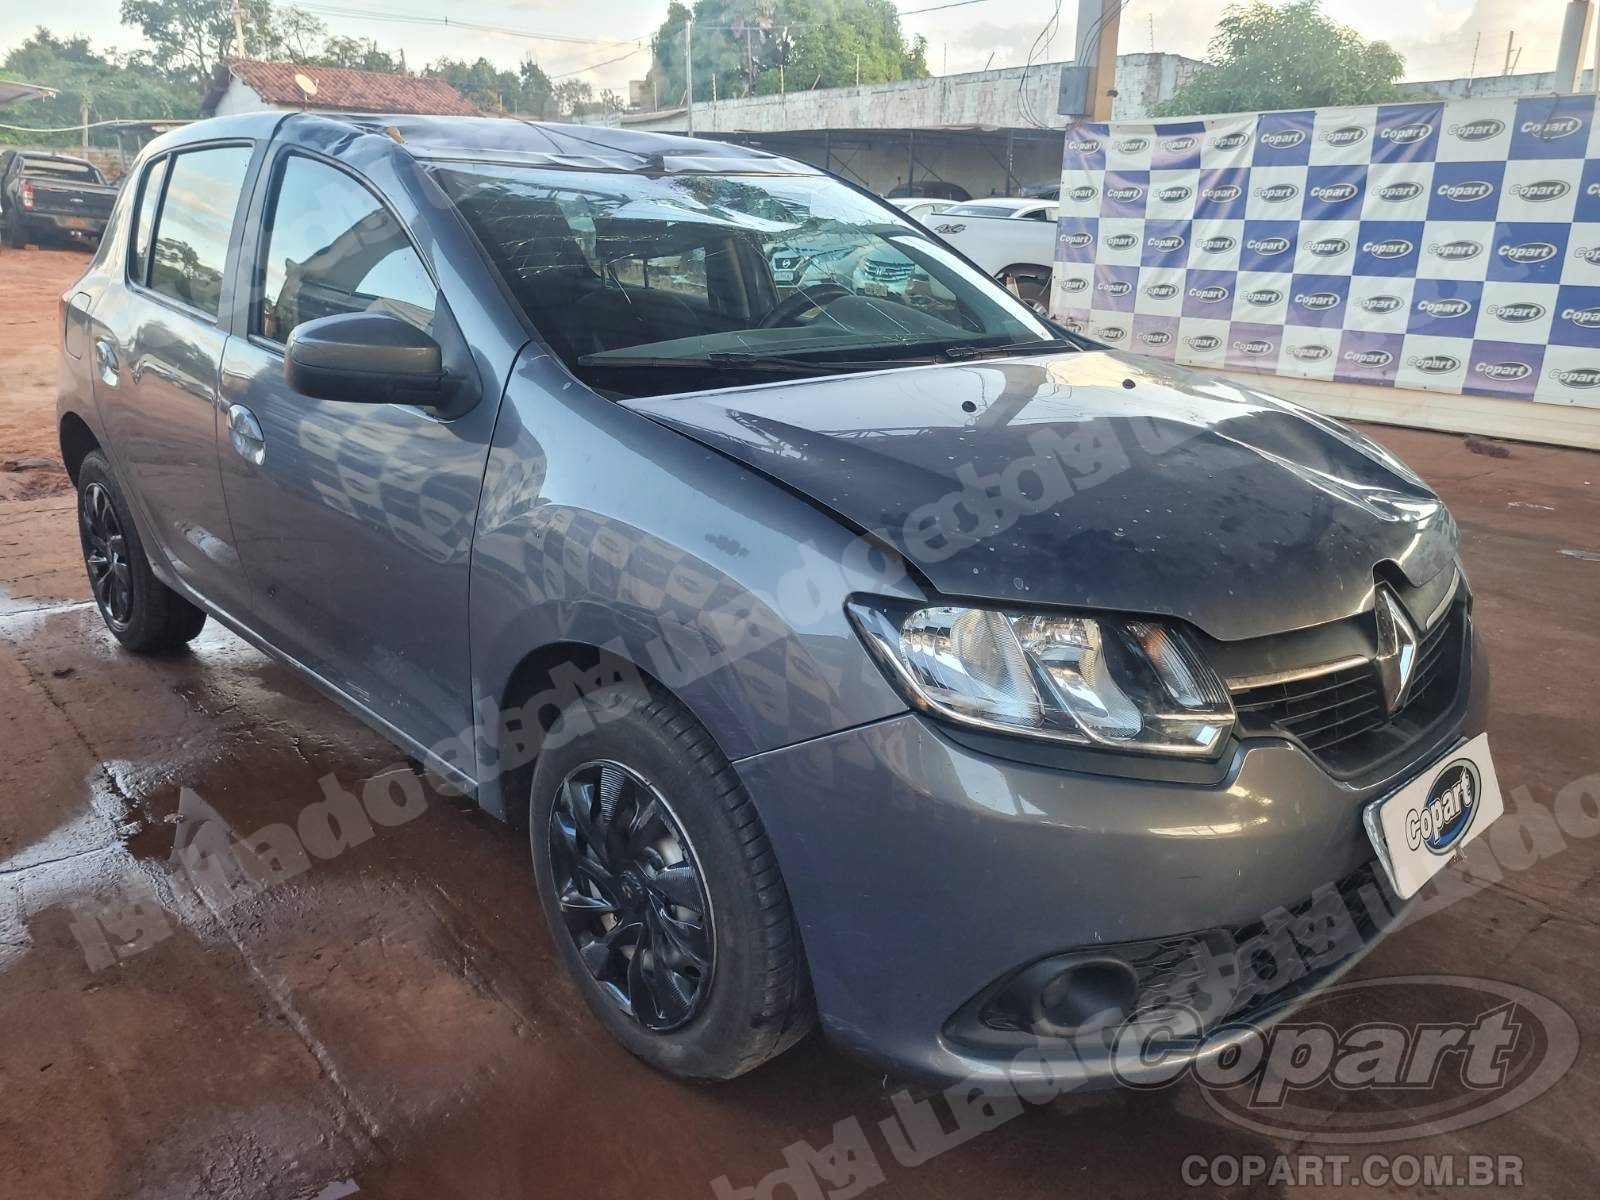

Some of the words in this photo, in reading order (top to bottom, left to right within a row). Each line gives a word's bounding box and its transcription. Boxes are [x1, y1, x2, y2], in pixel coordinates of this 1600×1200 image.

[1380, 126, 1426, 141] Copart
[1448, 122, 1497, 138] Copart
[1521, 119, 1574, 136] Coart
[1260, 131, 1300, 145] Copart
[1111, 140, 1147, 151] opart
[1064, 187, 1093, 198] opart
[1107, 187, 1138, 199] Copart
[1310, 185, 1351, 199] Copart
[1437, 183, 1487, 198] Copart
[1509, 183, 1562, 198] Copart
[1060, 233, 1089, 244] Copart
[1103, 236, 1134, 247] opart
[1148, 237, 1180, 249] Copart
[1247, 238, 1285, 251] Copart
[1362, 241, 1407, 255] Copart
[1498, 243, 1550, 258] Copart
[1057, 279, 1085, 290] opart
[1189, 287, 1225, 300] Copart
[1294, 293, 1335, 307] Copart
[1418, 299, 1465, 314] Copart
[1487, 303, 1539, 319] Copart
[1561, 307, 1600, 323] Copa
[1096, 328, 1123, 339] opart
[1344, 350, 1387, 364] Copart
[1475, 361, 1527, 377] Copart
[1405, 766, 1473, 851] Copart
